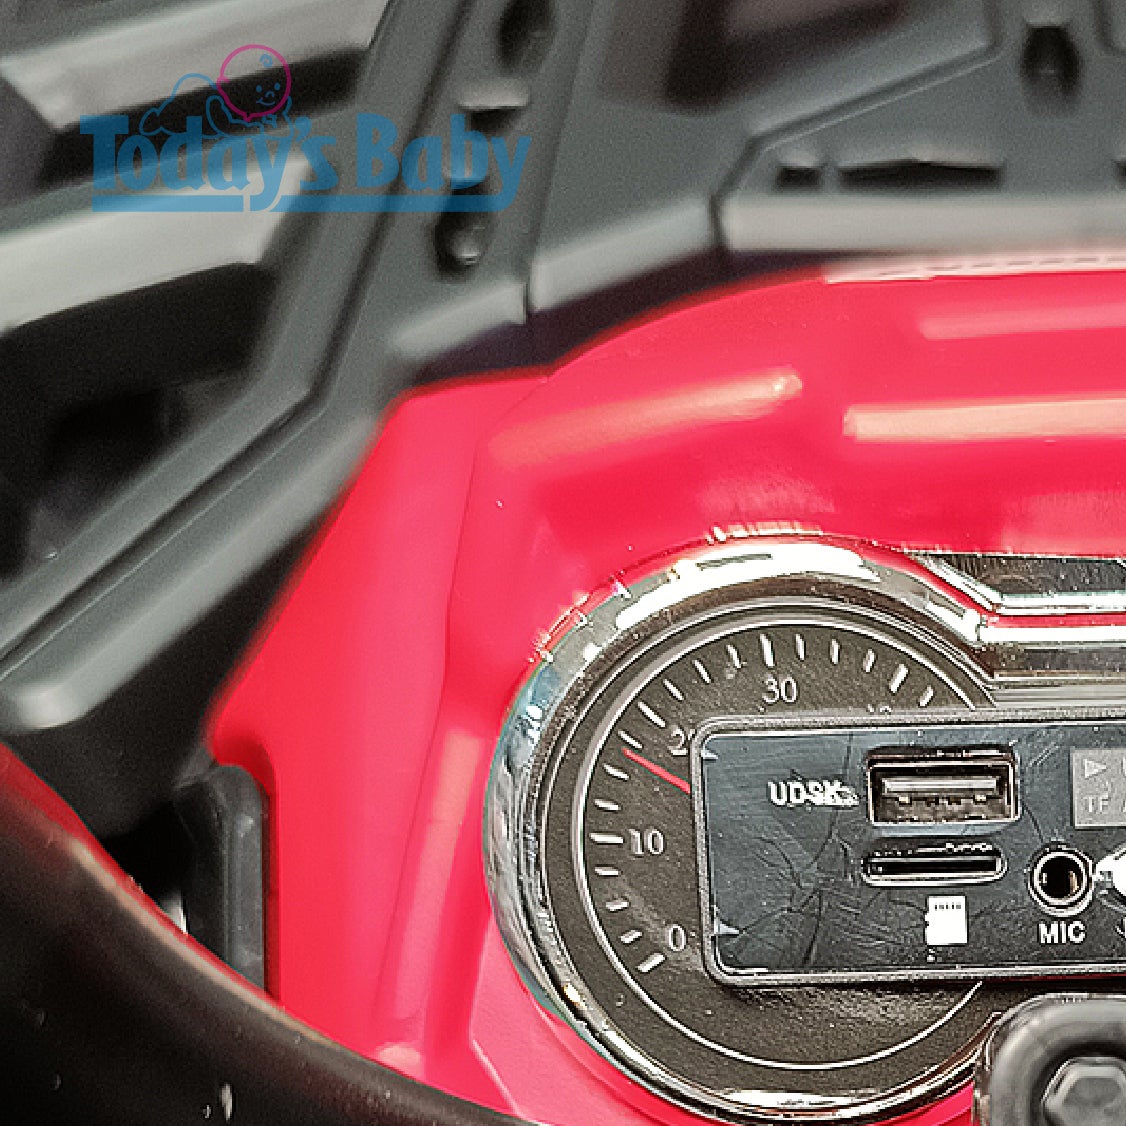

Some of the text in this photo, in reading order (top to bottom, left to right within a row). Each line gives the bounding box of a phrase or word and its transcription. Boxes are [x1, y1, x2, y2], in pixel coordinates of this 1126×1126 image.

[762, 677, 797, 703] 30
[627, 828, 664, 855] 10
[667, 923, 686, 951] 0
[1038, 920, 1087, 945] MIC
